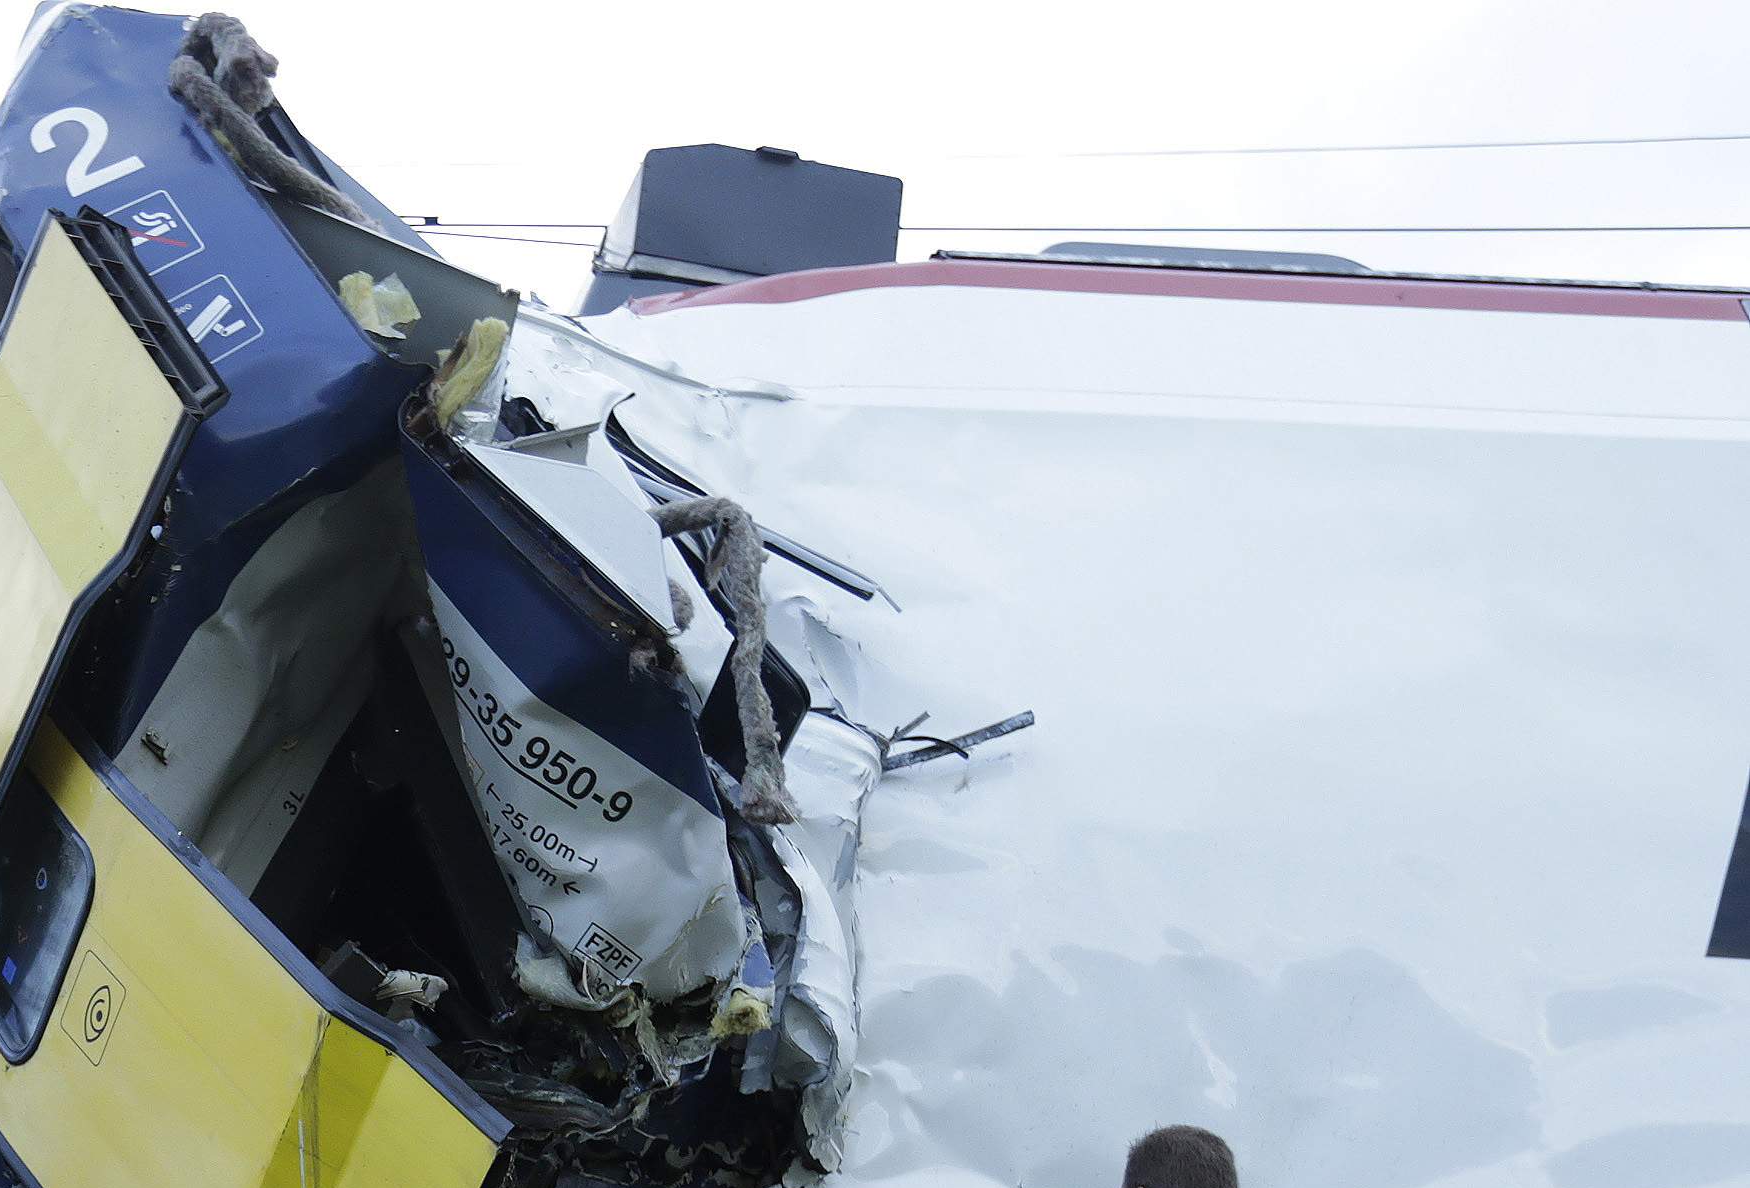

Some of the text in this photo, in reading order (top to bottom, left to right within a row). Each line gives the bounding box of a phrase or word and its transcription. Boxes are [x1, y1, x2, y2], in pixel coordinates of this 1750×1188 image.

[30, 106, 146, 198] 2
[519, 736, 634, 823] 950-9
[491, 823, 558, 888] 17.60m
[501, 802, 576, 862] 25.00m
[584, 931, 634, 971] FZPF
